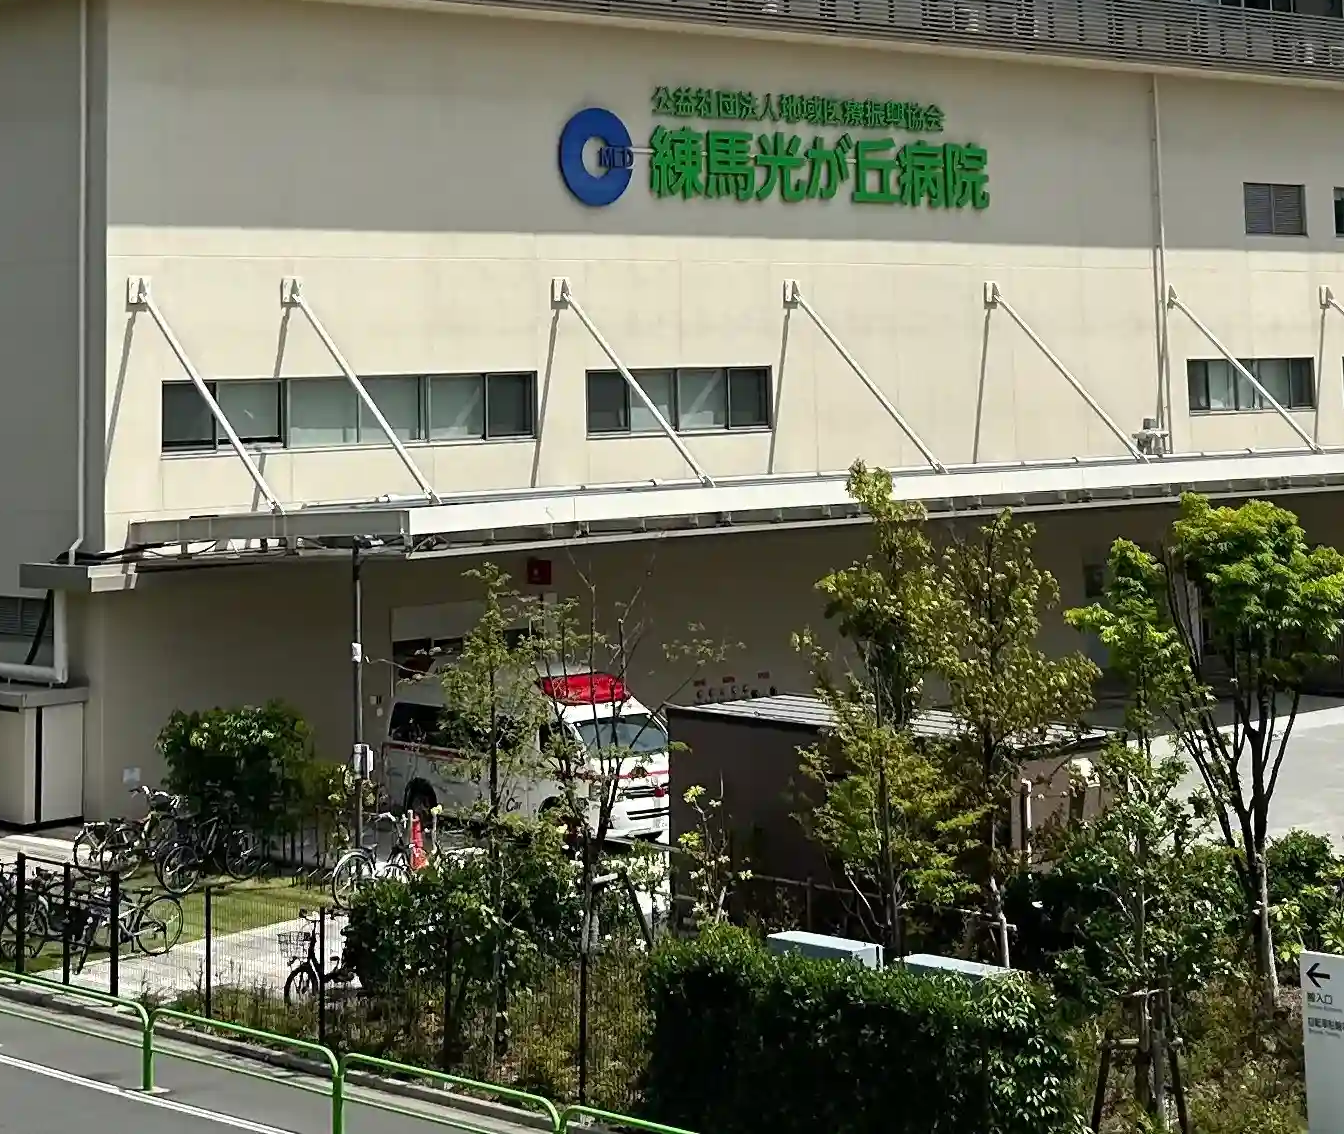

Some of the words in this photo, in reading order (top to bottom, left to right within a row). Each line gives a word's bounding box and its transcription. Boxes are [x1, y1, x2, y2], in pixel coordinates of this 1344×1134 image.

[650, 124, 990, 209] 練馬光が丘病院
